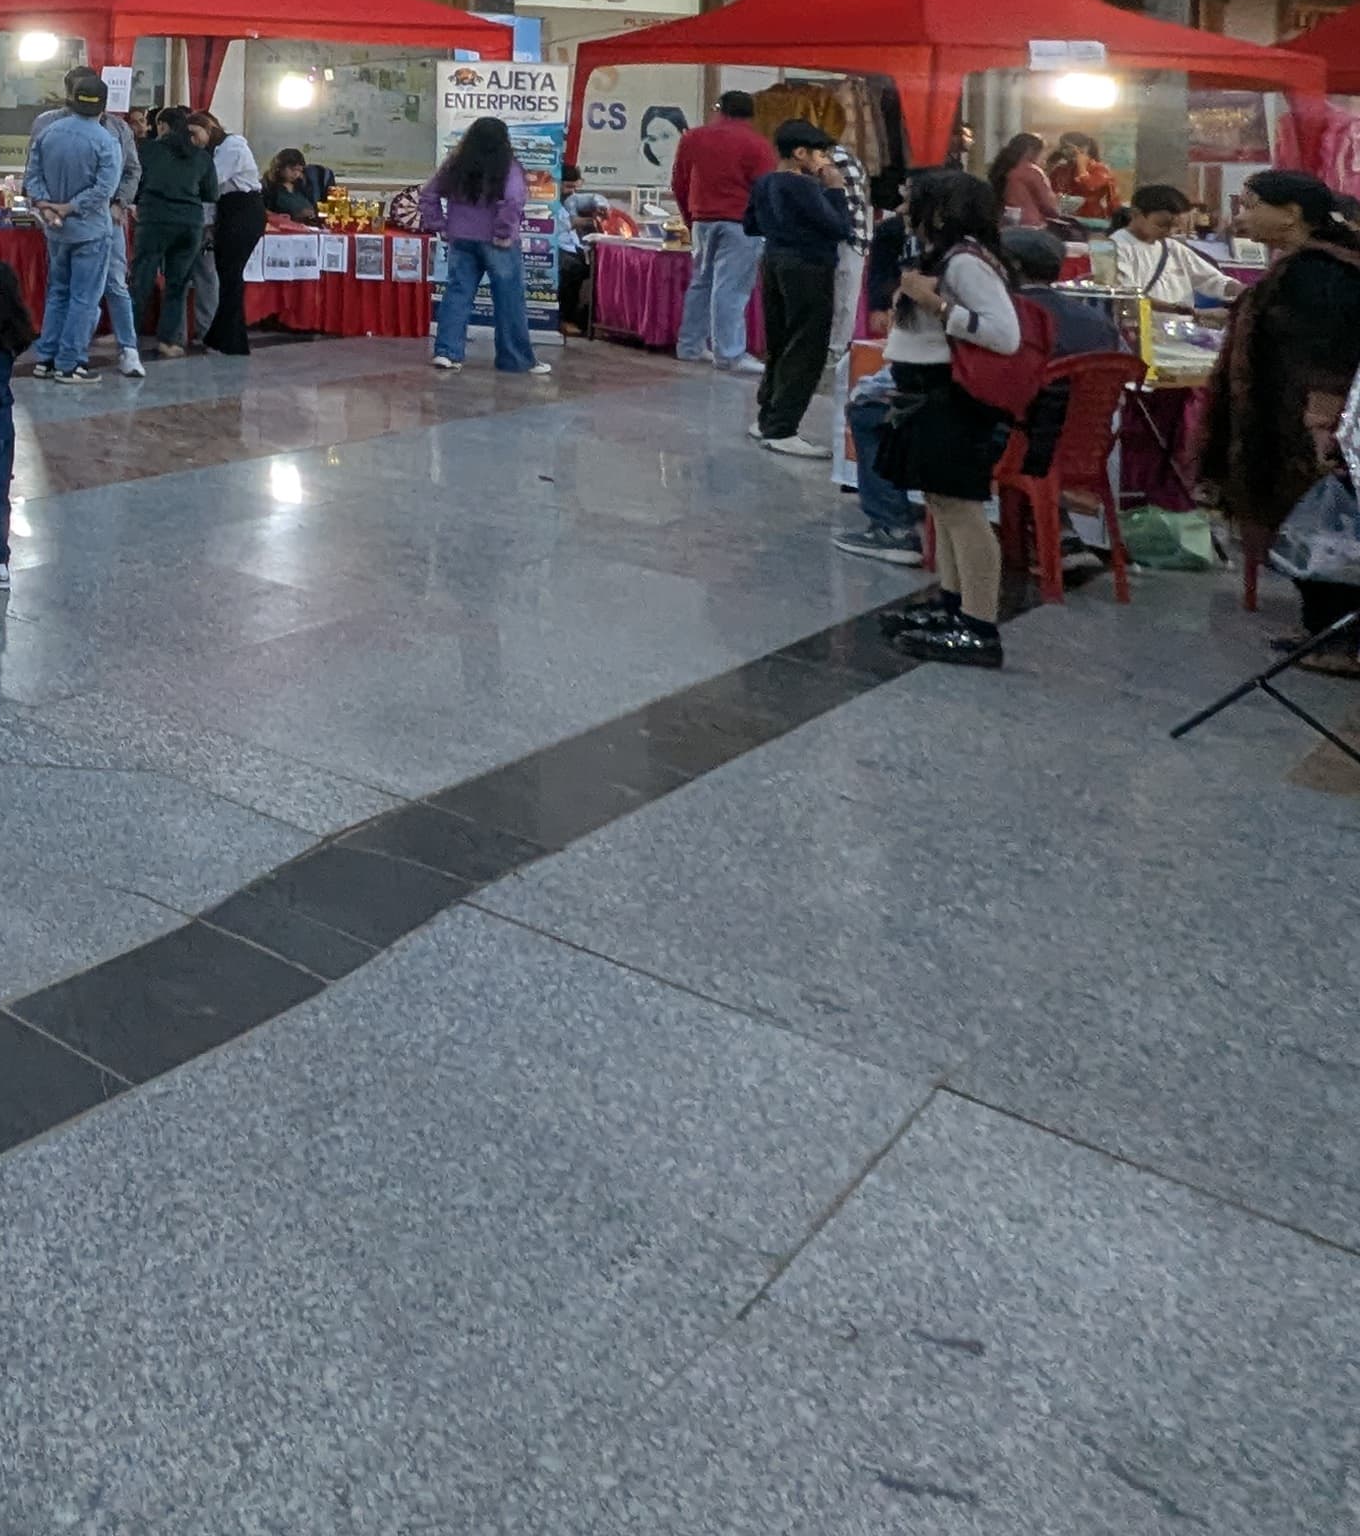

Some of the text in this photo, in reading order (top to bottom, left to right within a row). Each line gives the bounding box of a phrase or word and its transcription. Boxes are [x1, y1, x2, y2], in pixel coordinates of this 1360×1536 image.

[487, 70, 556, 92] AJEYA
[444, 93, 559, 112] ENTERPRISES
[588, 102, 627, 130] CS
